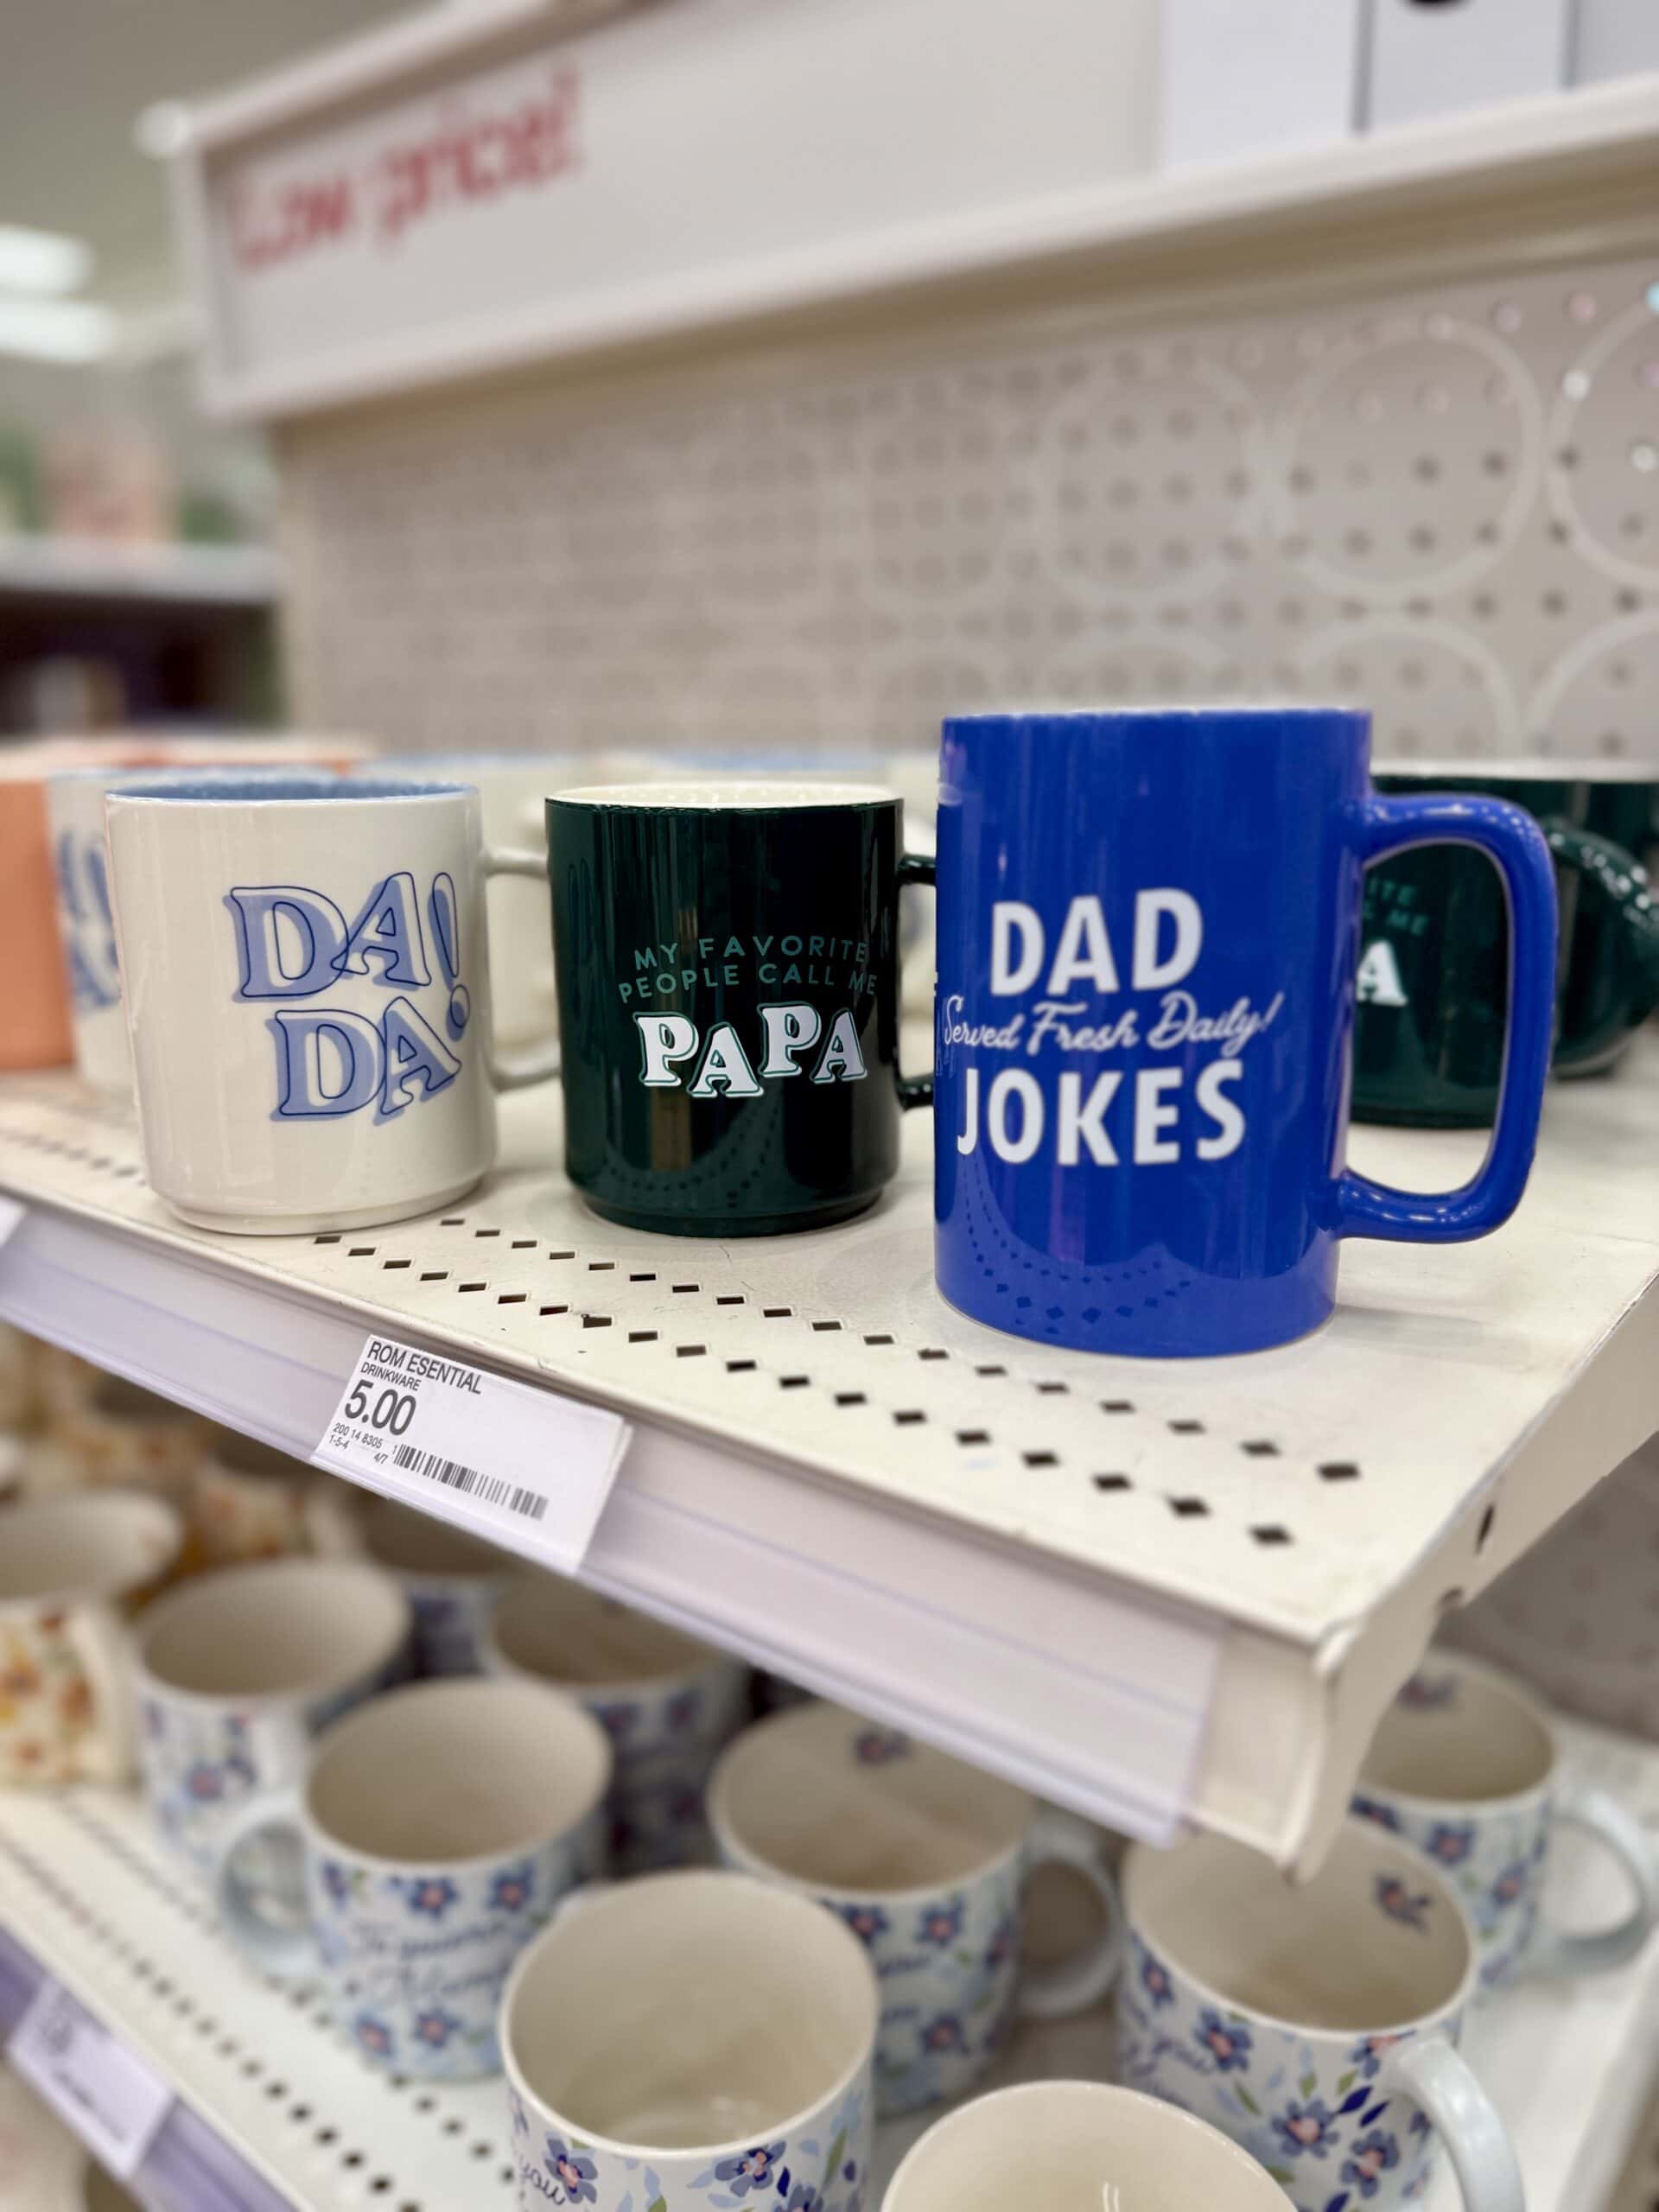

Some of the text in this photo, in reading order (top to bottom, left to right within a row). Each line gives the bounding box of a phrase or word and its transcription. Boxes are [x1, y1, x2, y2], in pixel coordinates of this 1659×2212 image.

[634, 935, 868, 970] MY FAVORITE
[990, 887, 1204, 995] DAD
[619, 963, 878, 1003] PEOPLE CALL ME
[632, 1001, 868, 1098] PAPA
[944, 990, 1284, 1058] Served Fresh Daily!
[265, 996, 461, 1125] DA
[957, 1058, 1246, 1166] JOKES
[360, 1362, 422, 1392] DRINKWARE
[367, 1340, 481, 1395] ROM ESENTIAL
[333, 1422, 350, 1436] 200
[351, 1428, 362, 1440] 14
[345, 1379, 416, 1435] 5.00
